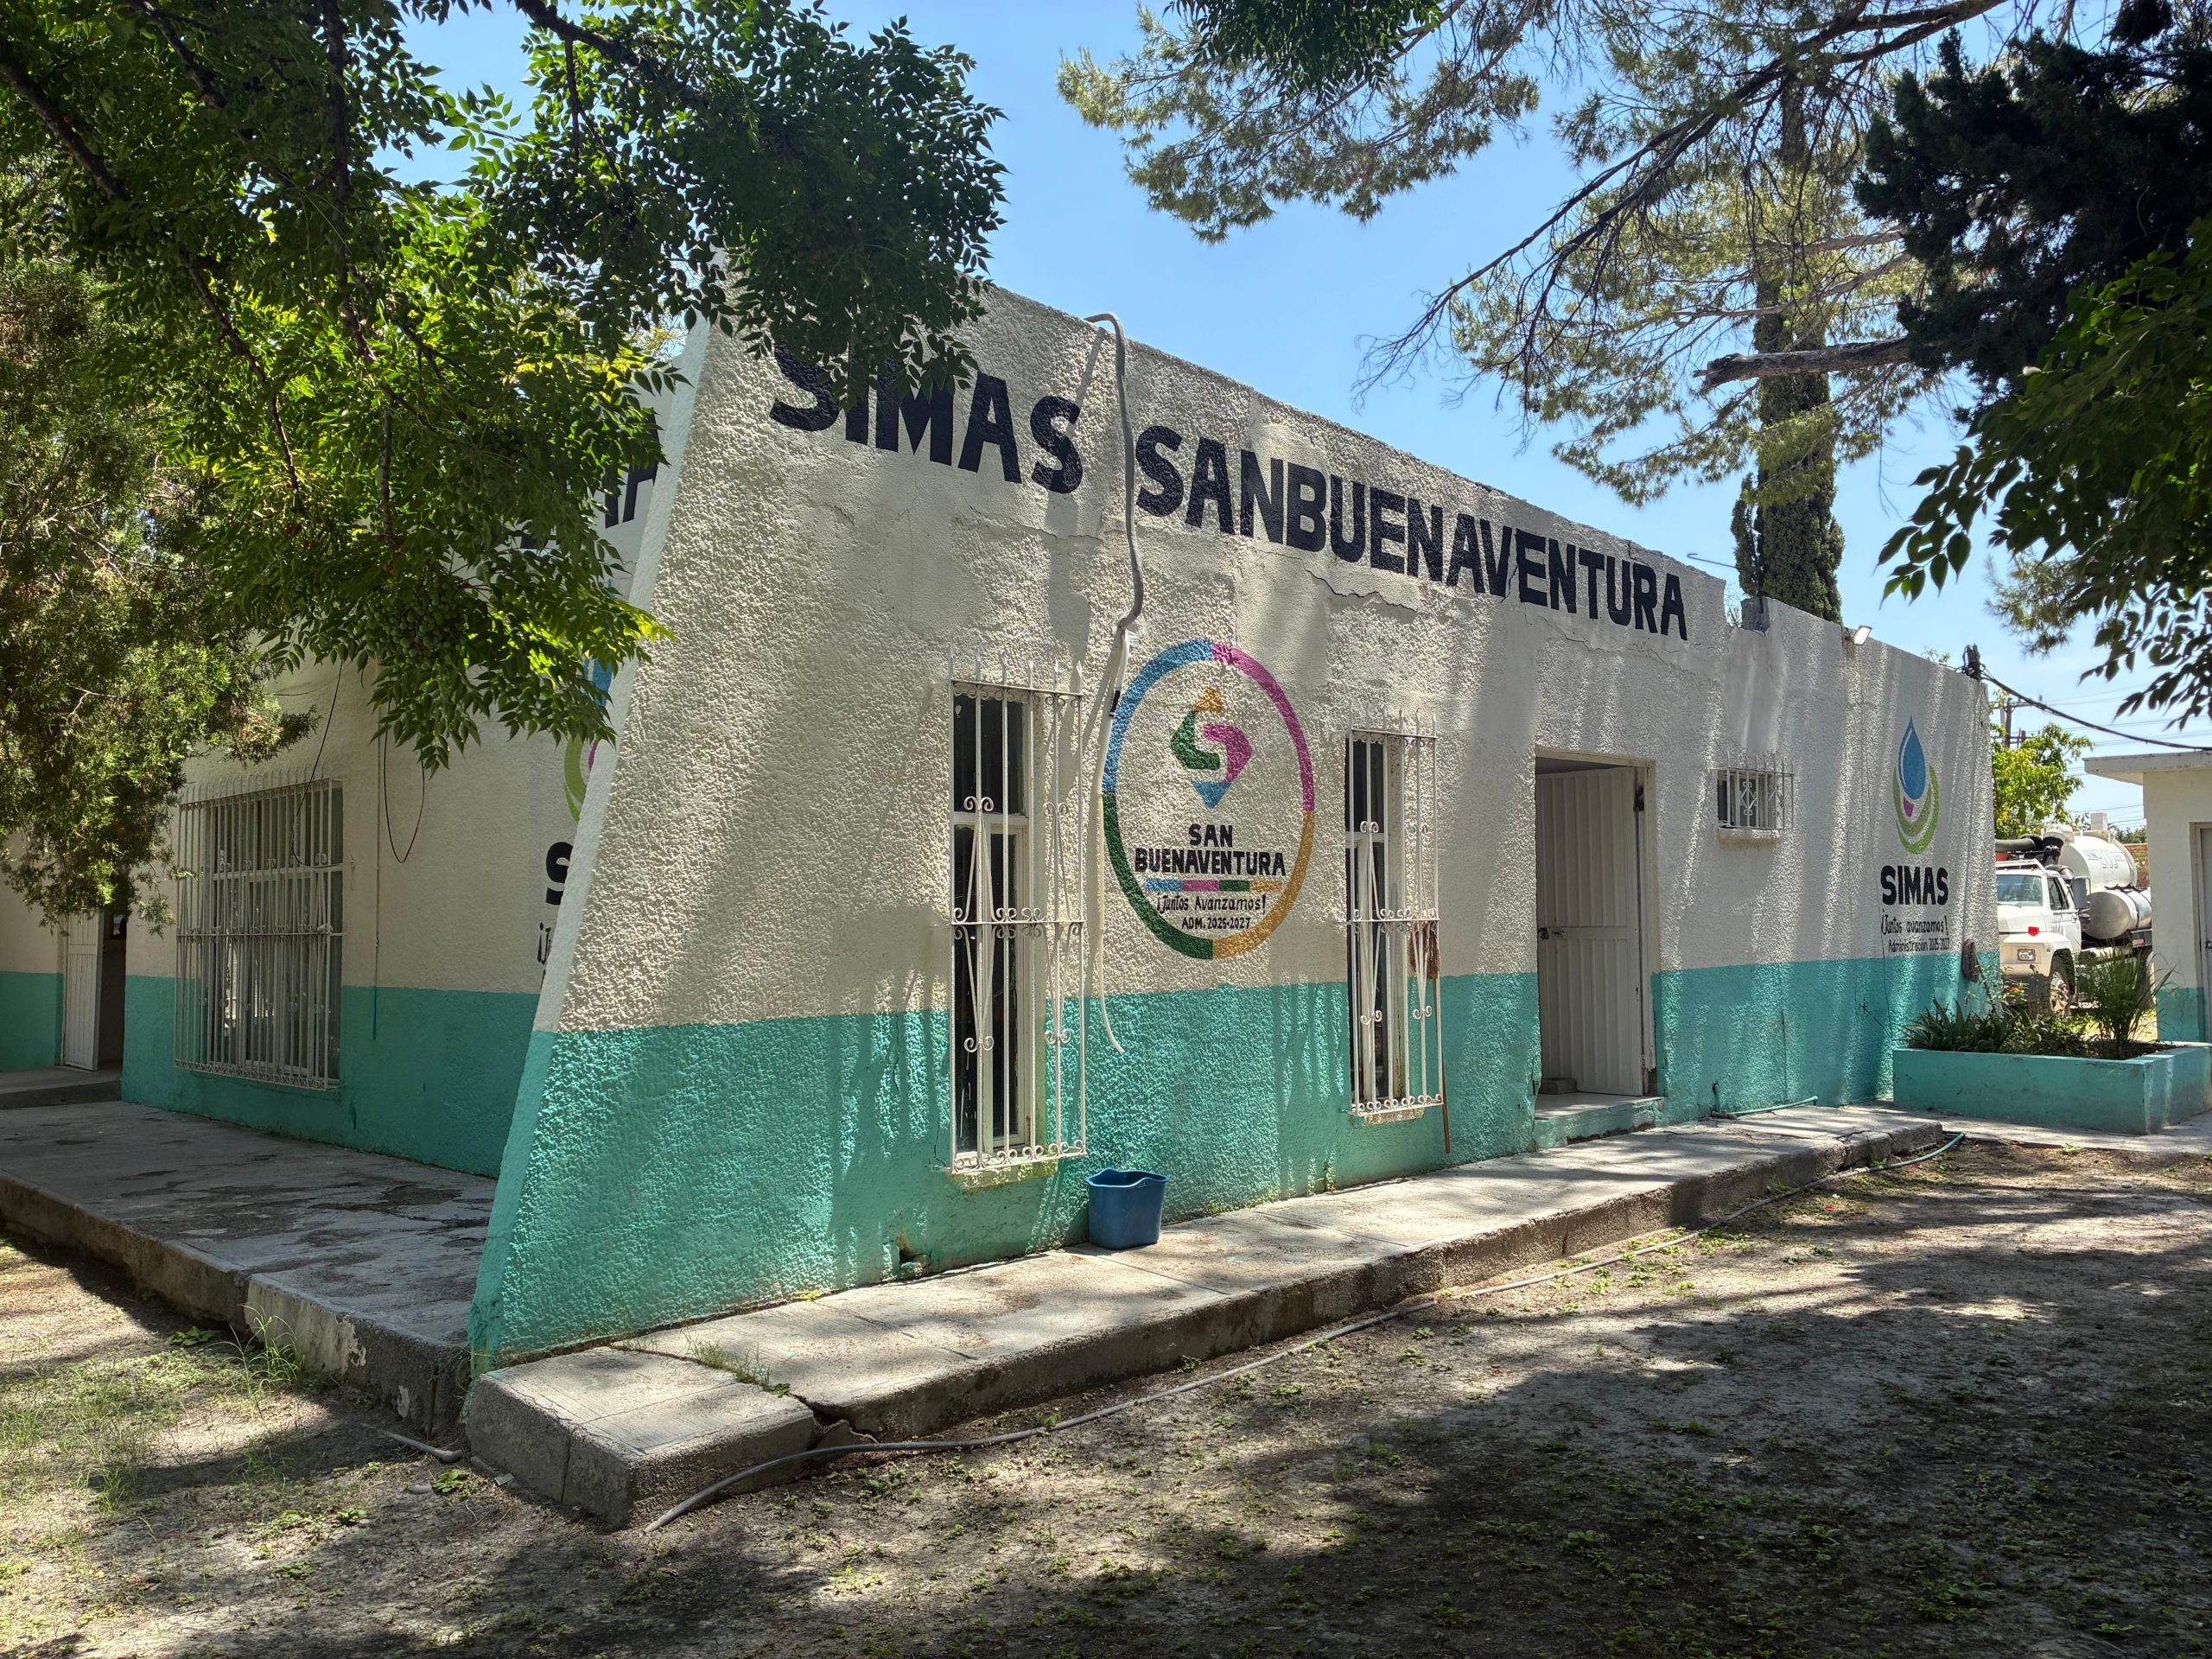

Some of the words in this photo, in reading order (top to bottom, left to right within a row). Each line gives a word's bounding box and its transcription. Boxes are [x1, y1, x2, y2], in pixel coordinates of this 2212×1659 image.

[1135, 426, 1688, 640] SANBUENAVENTURA
[1189, 823, 1233, 848] SAN
[1135, 848, 1286, 876] BUENAVENTURA
[1881, 865, 1948, 906] SIMAS
[1194, 894, 1267, 915] Avanzamos!
[1182, 918, 1206, 930] ADM.
[1208, 917, 1251, 930] 2025-2027
